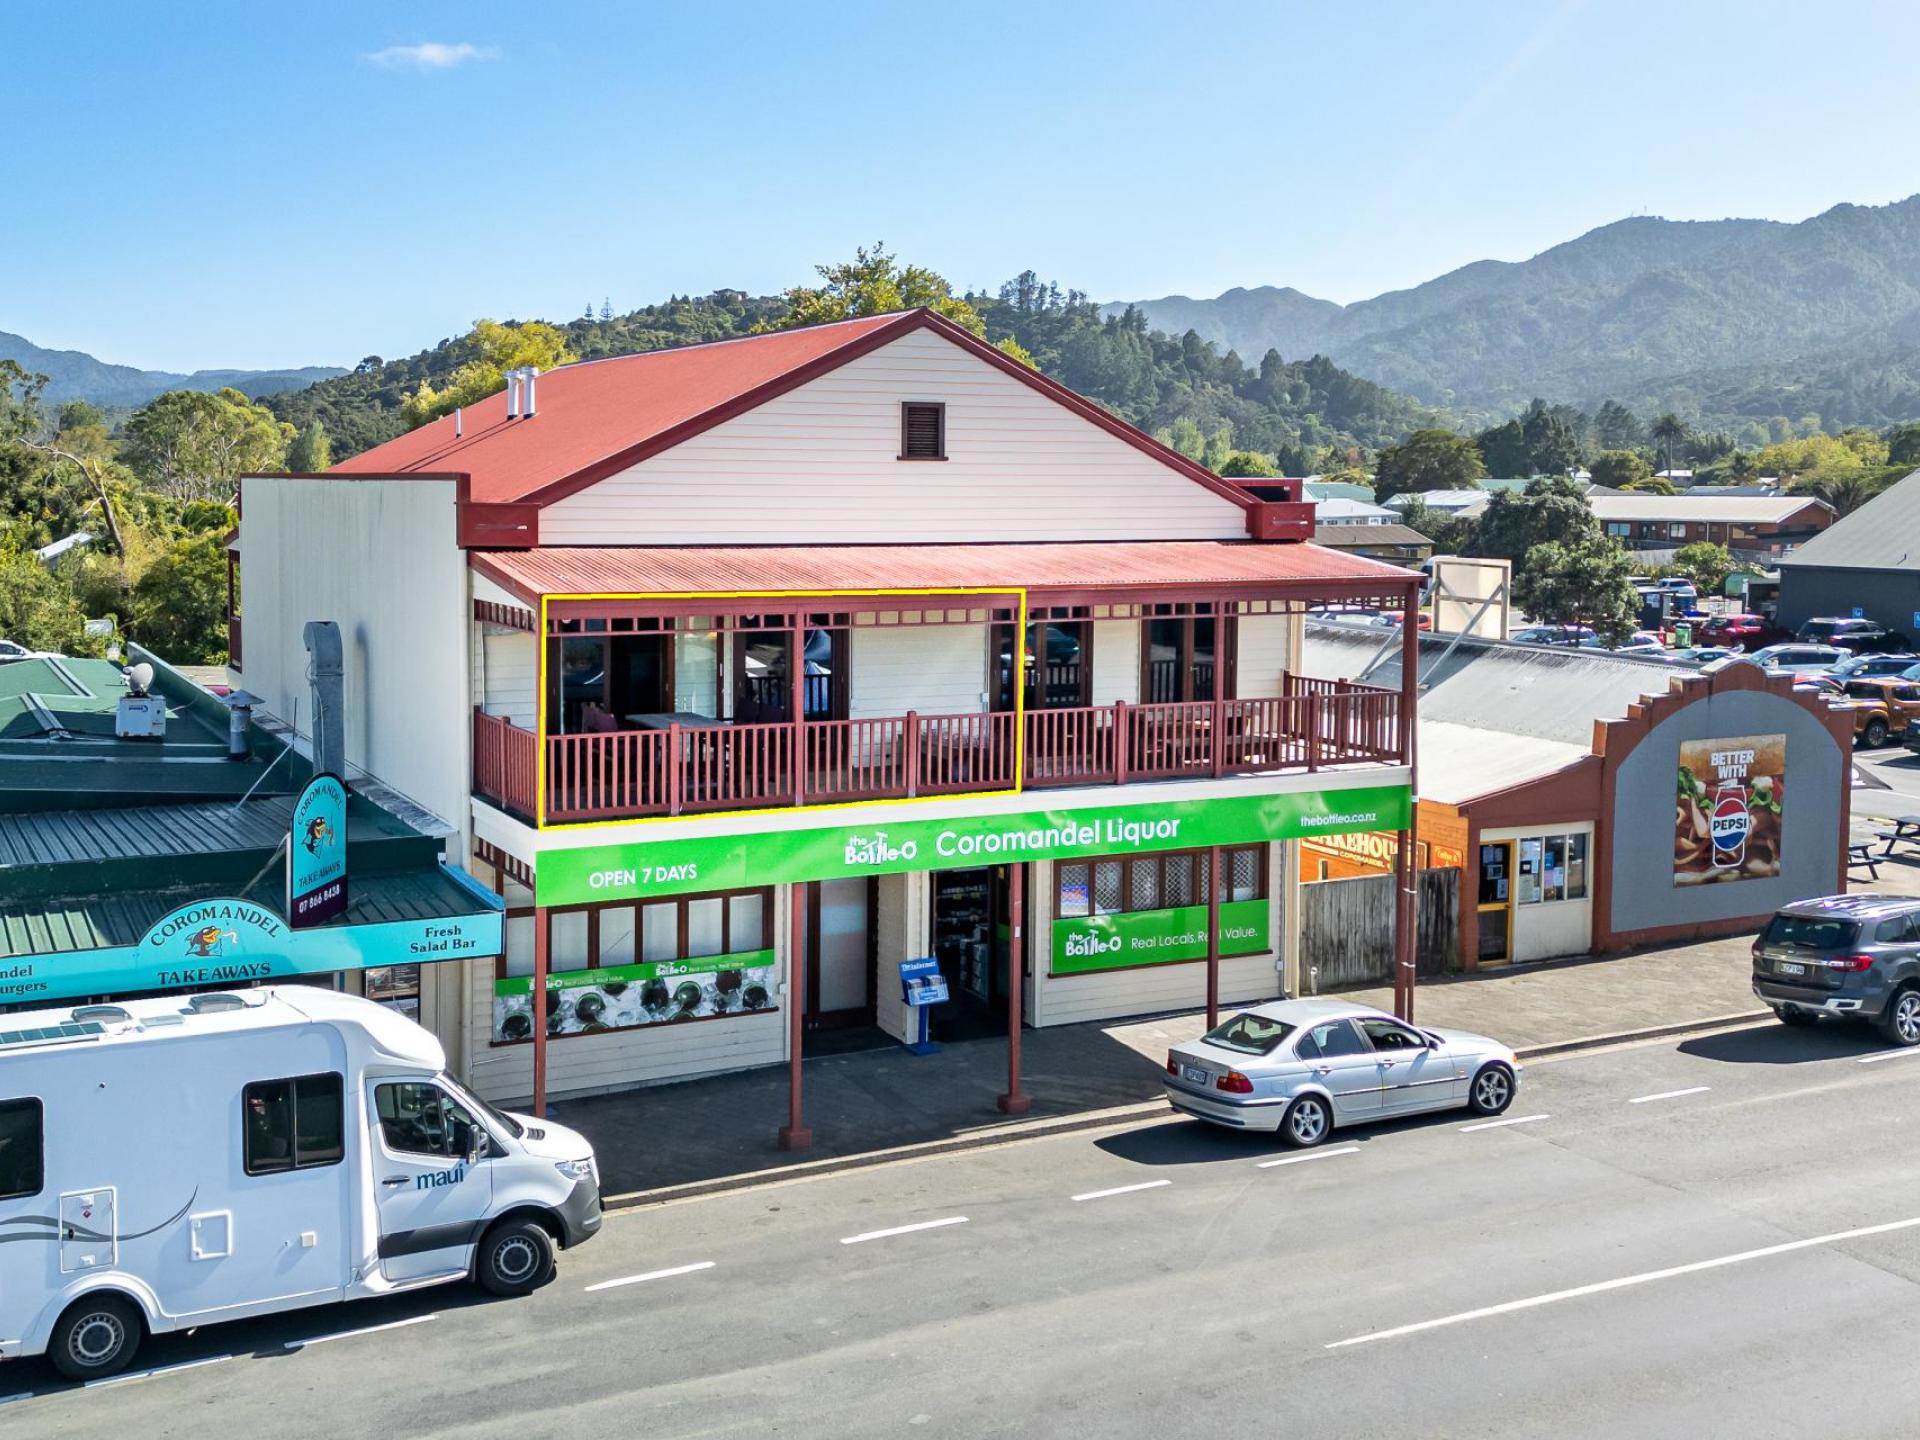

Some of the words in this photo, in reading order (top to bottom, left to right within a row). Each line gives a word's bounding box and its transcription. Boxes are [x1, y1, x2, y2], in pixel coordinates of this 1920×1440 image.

[1711, 750, 1754, 766] BETTER
[1718, 765, 1747, 779] WITH
[298, 784, 342, 825] COROMANDEL
[1301, 812, 1377, 827] thebottleo.co.nz
[1713, 818, 1747, 831] PEPSI
[936, 820, 1100, 856] Coromandel
[1107, 818, 1181, 846] Liquor
[299, 861, 341, 888] TAKEAWAYS
[589, 869, 636, 888] OPEN
[642, 867, 652, 884] 7
[656, 863, 697, 882] DAYS
[299, 899, 308, 913] 07
[151, 905, 281, 946] COROMANDEL
[425, 925, 462, 938] Fresh
[410, 940, 448, 954] Salad
[452, 938, 476, 950] Bar
[1131, 937, 1157, 950] Real
[1197, 930, 1222, 943] Rel
[1225, 927, 1258, 940] Value.
[0, 965, 32, 978] ndel
[158, 962, 271, 985] TAKEAWAYS
[0, 982, 48, 995] urgers
[417, 1163, 464, 1190] maui
